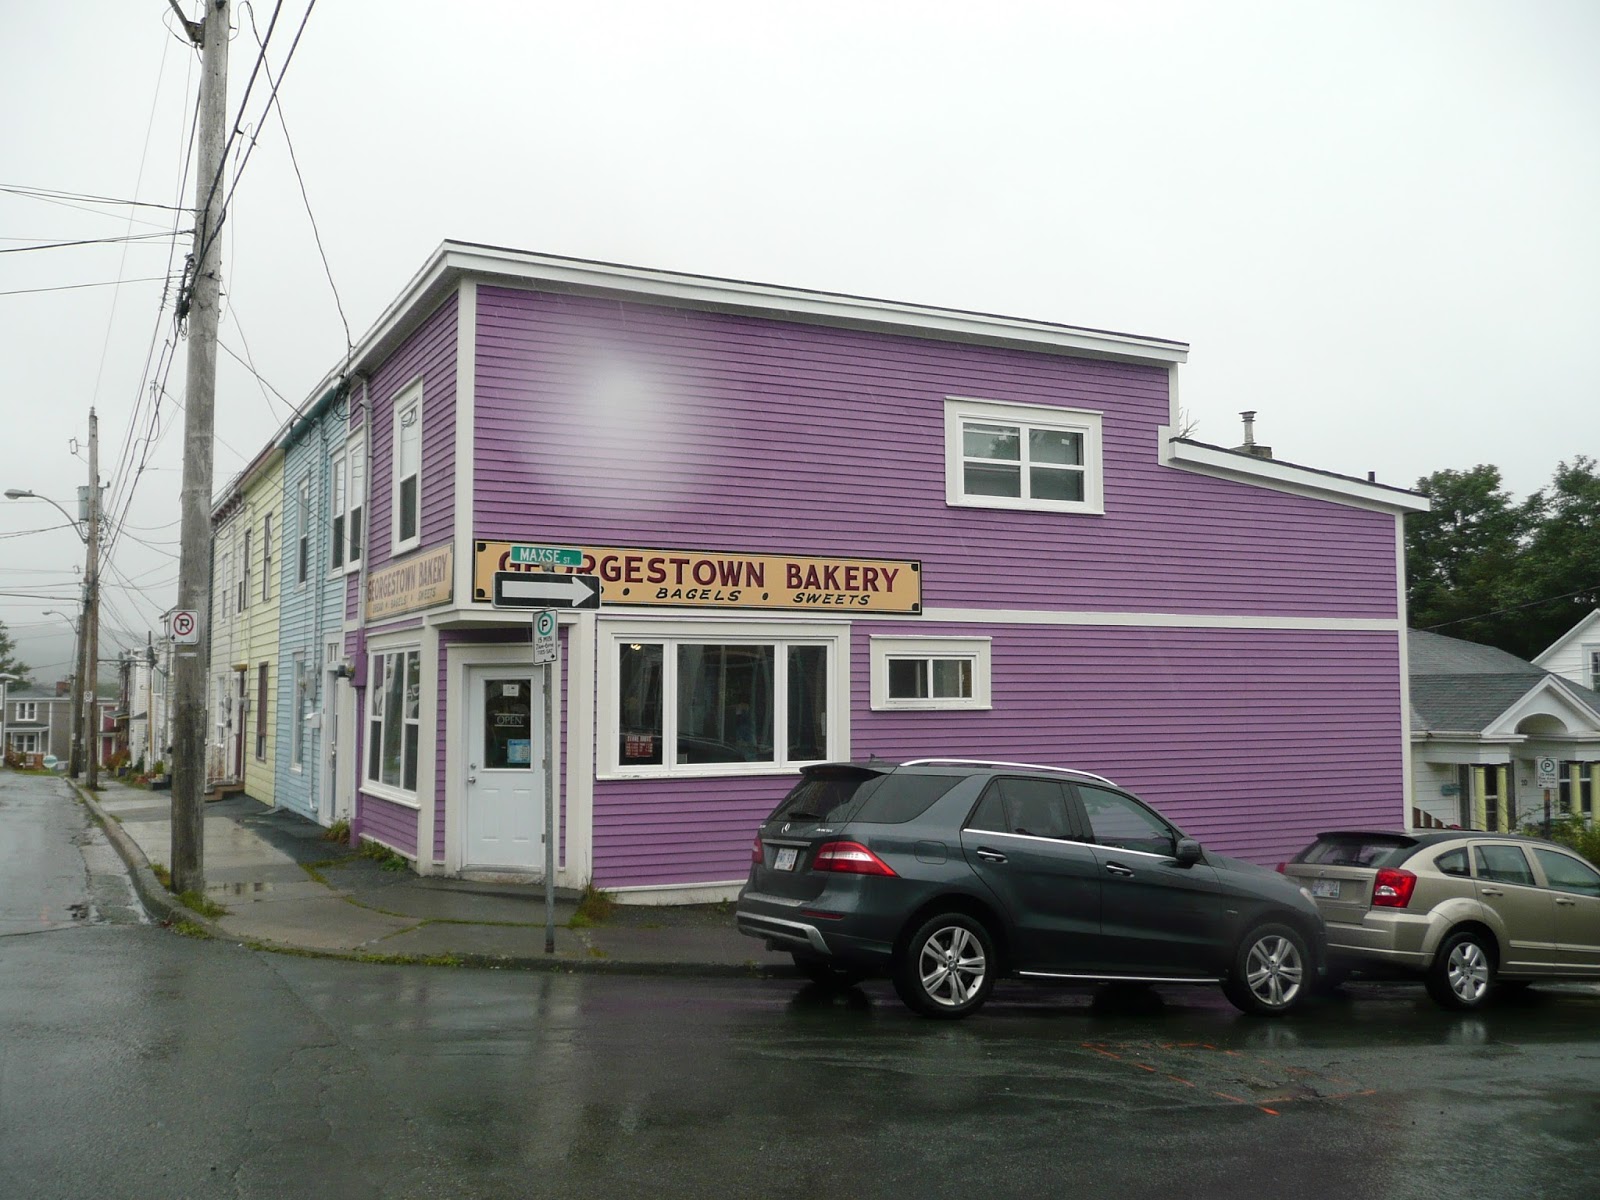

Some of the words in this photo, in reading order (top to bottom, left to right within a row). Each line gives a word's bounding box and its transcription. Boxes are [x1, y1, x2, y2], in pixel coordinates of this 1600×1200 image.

[520, 548, 561, 564] MAXSE
[562, 556, 571, 564] ST
[419, 553, 448, 588] BAKERY
[786, 563, 900, 593] BAKERY
[655, 587, 742, 601] BAGELS
[793, 592, 871, 606] SWEETS
[496, 715, 522, 725] OPEN
